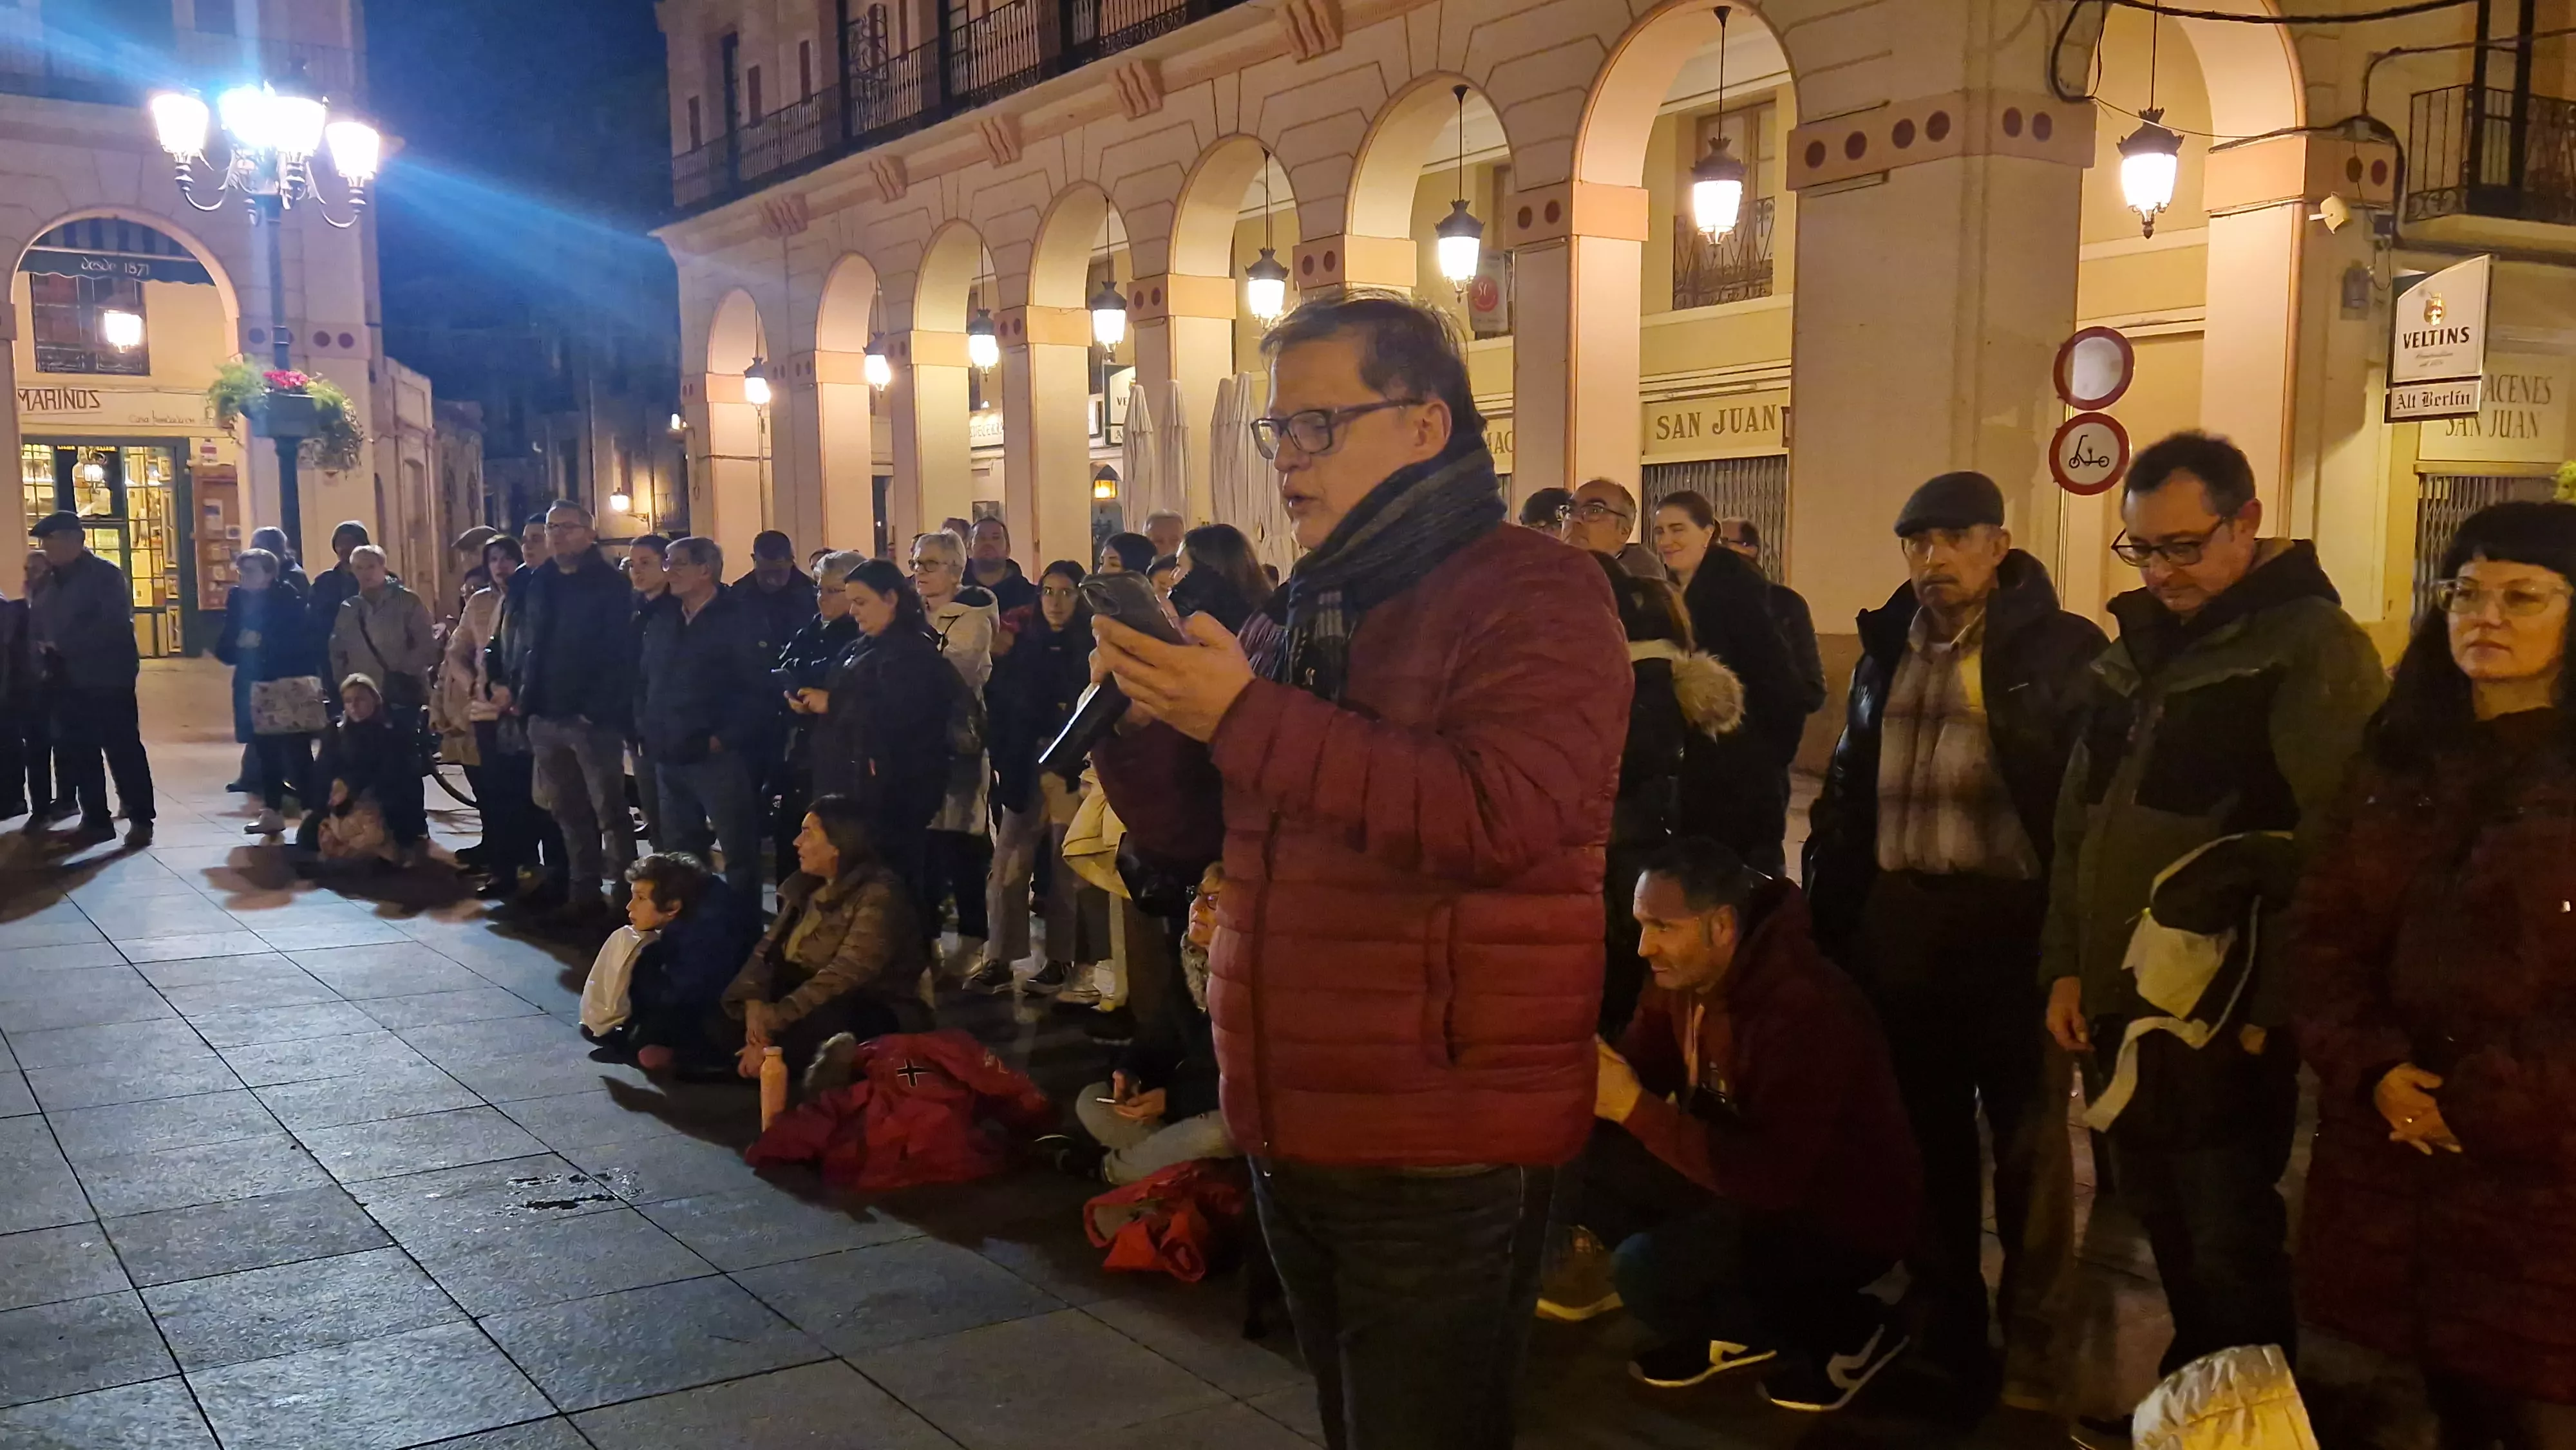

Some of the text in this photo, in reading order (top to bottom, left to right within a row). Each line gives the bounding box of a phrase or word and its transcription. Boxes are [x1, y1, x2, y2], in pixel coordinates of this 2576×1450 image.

[81, 256, 149, 276] desde 1871
[2403, 326, 2470, 350] VELTINS
[2396, 393, 2416, 410] Alt
[1656, 404, 1777, 440] SAN JUAN
[2446, 410, 2539, 438] SAN JUAN
